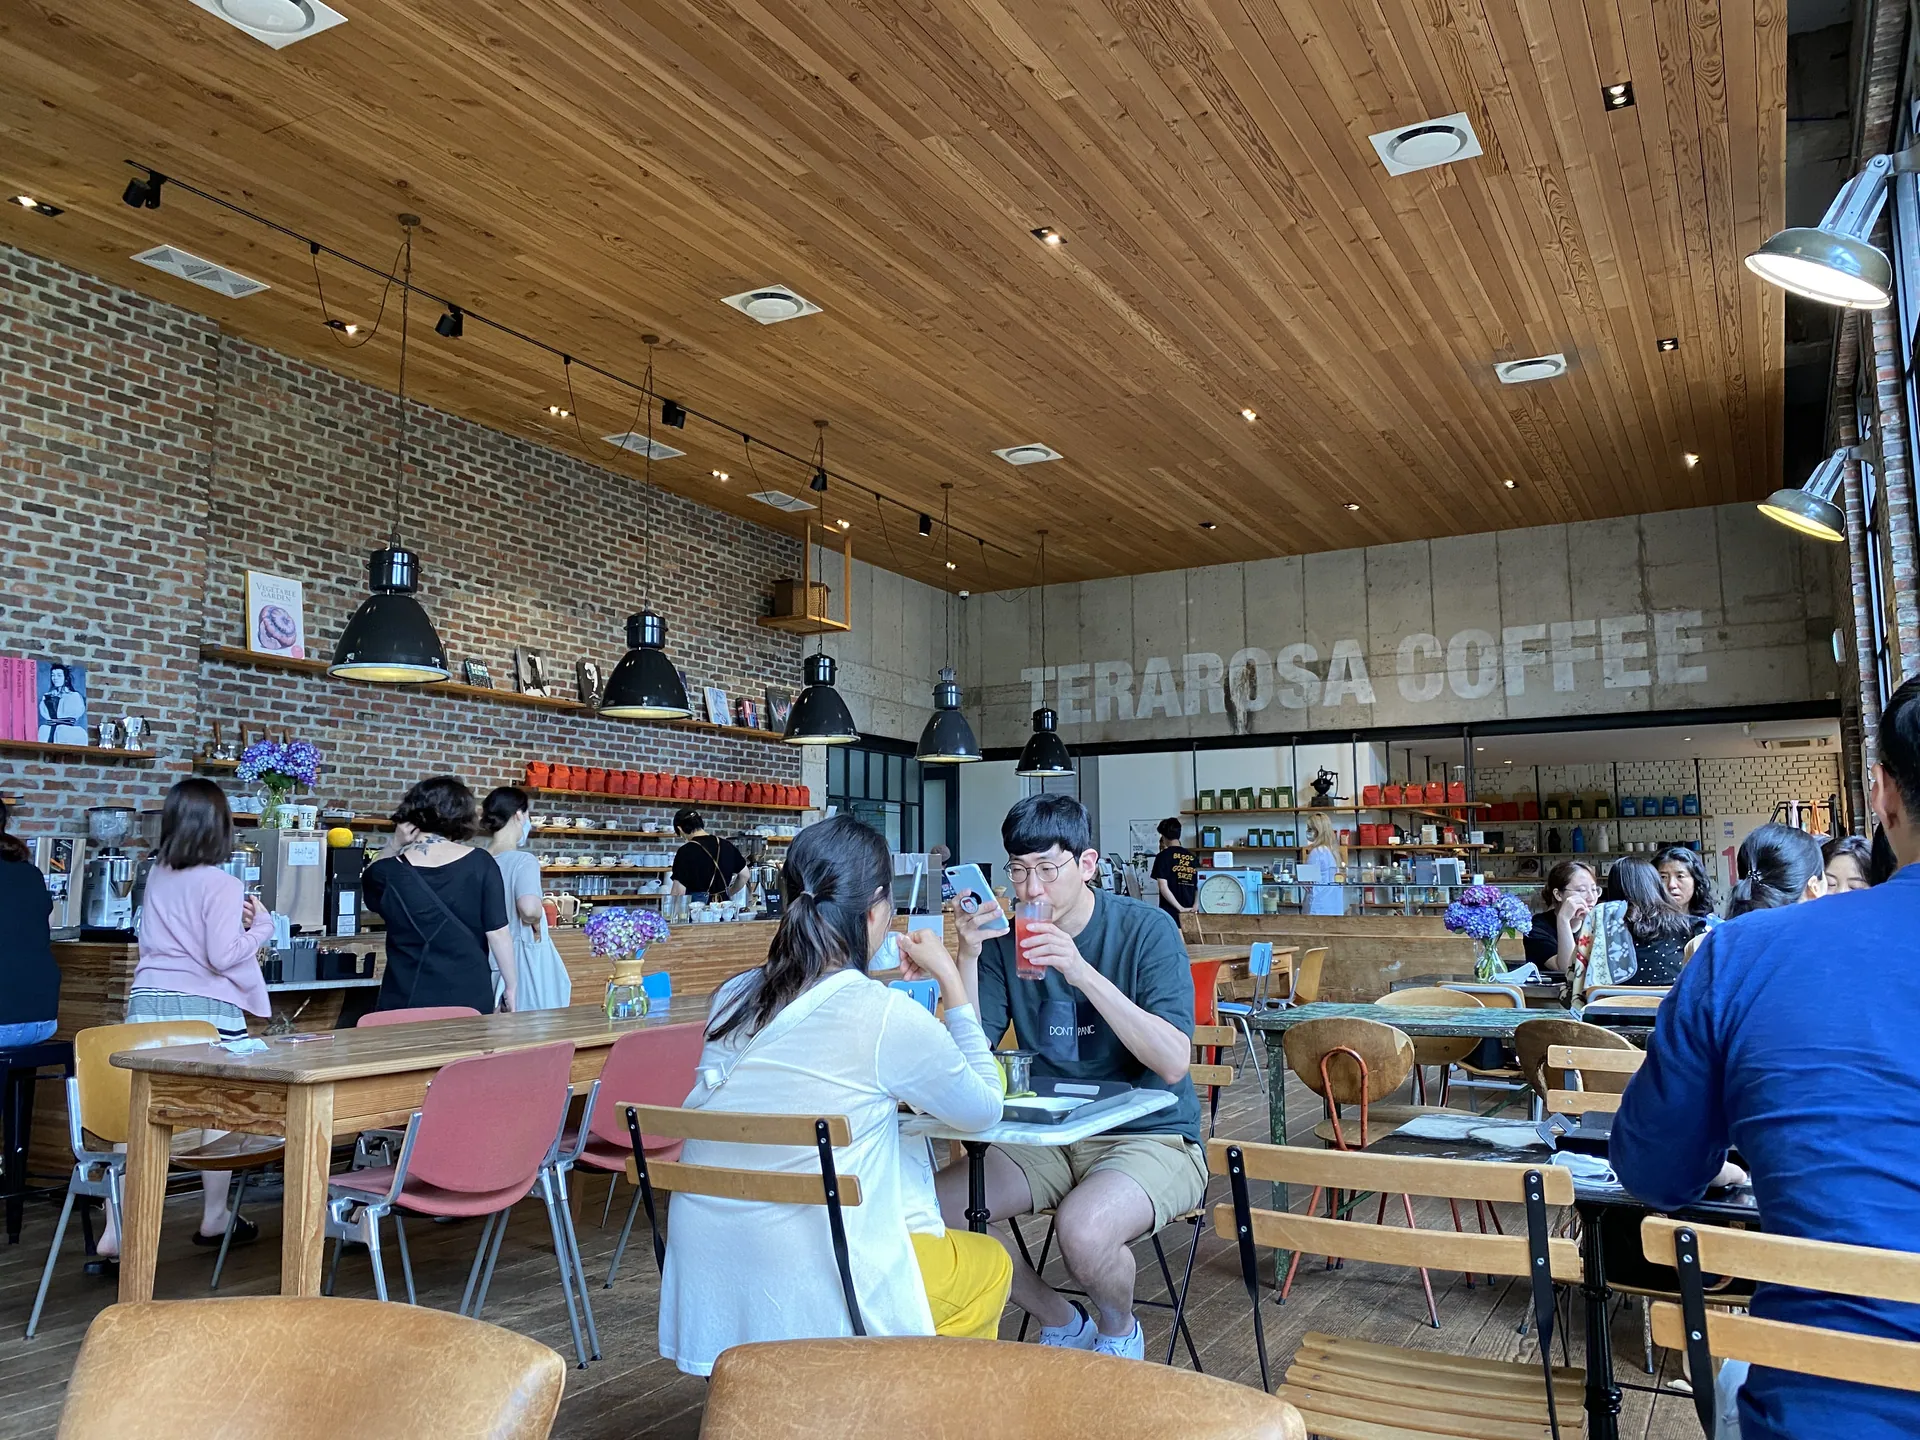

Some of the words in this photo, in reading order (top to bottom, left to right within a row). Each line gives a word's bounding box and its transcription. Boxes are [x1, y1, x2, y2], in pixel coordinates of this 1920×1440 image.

[1021, 639, 1376, 725] TERAROSA
[1399, 610, 1708, 700] COFFEE
[1078, 1025, 1095, 1036] PANIC
